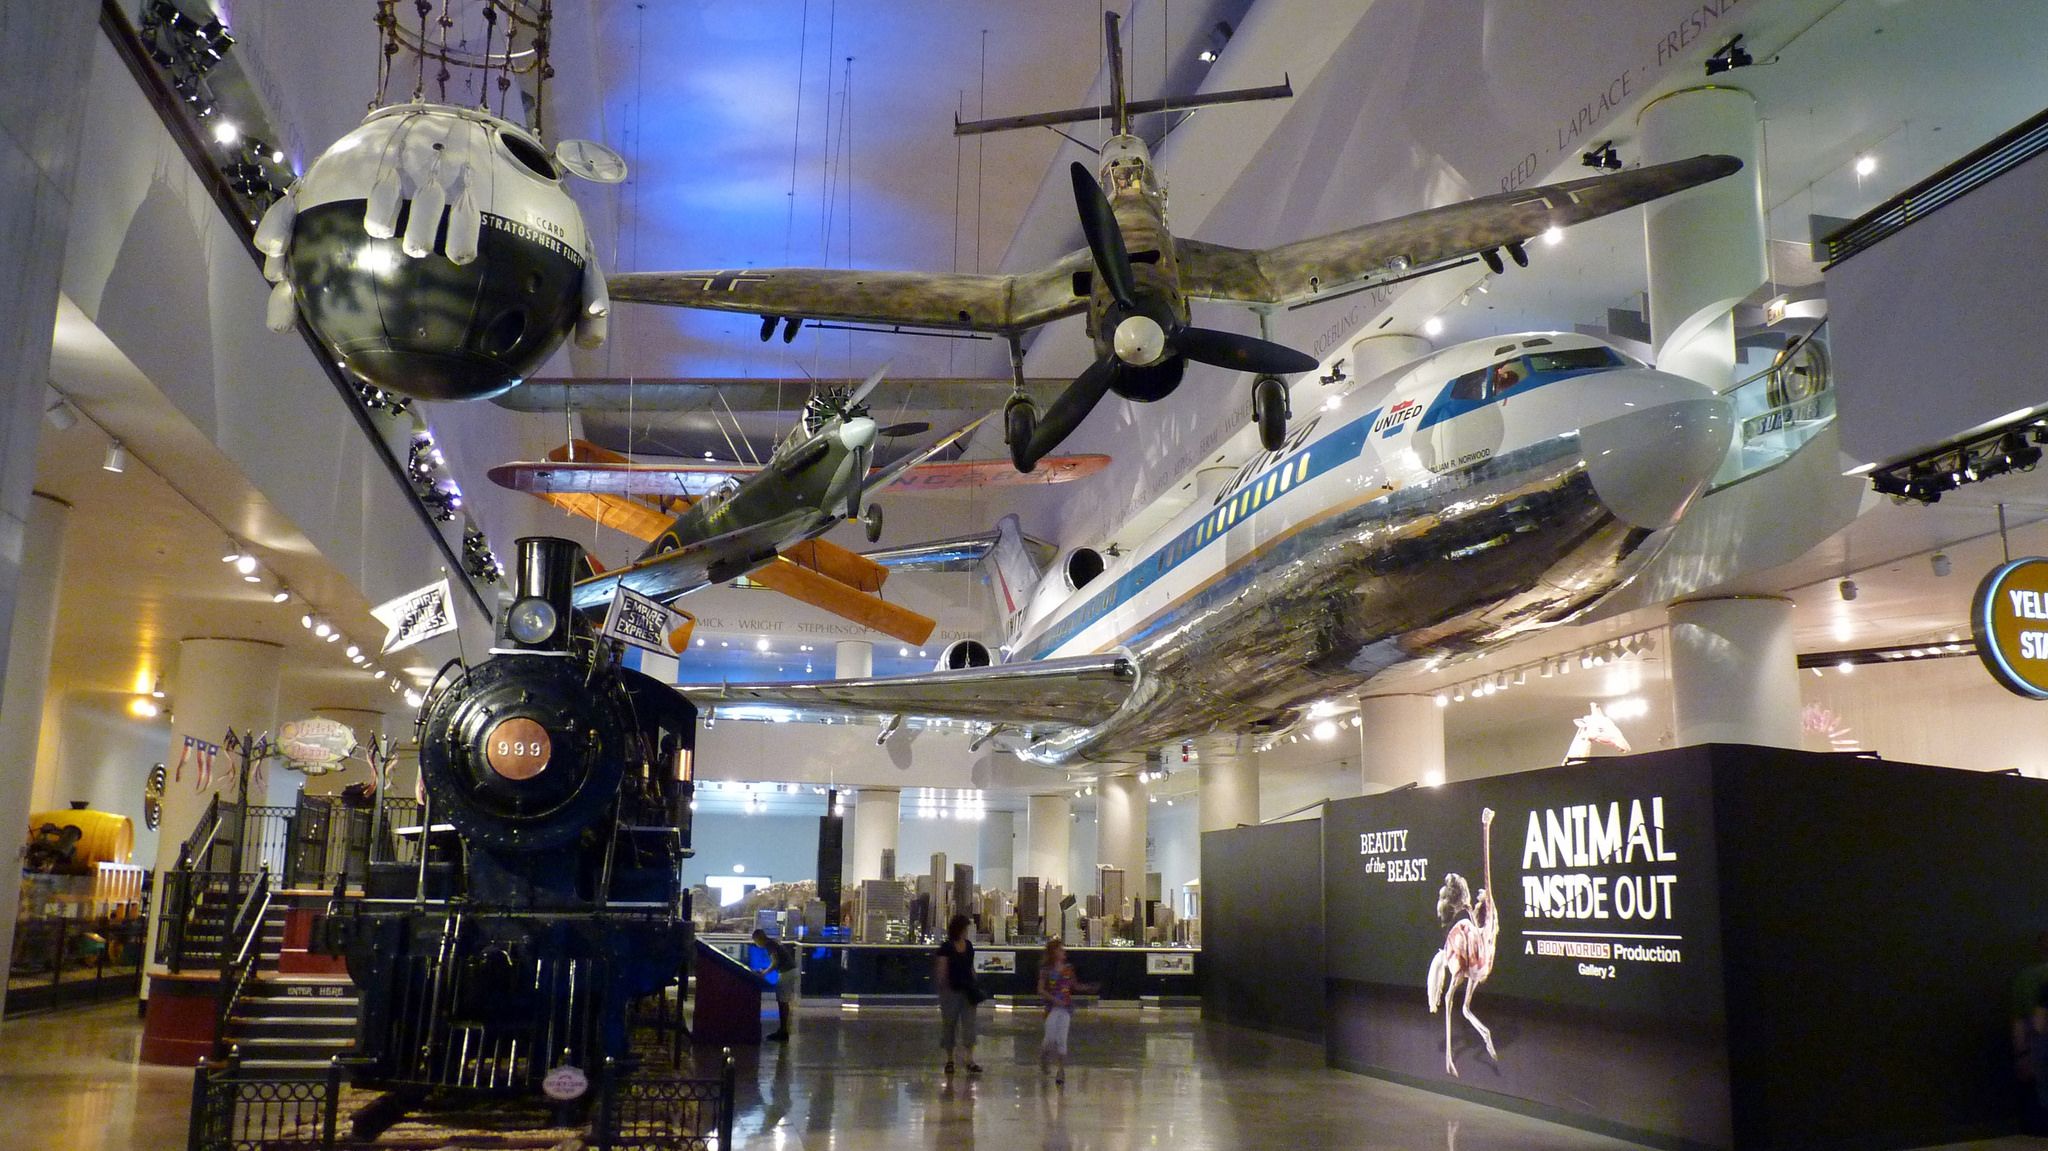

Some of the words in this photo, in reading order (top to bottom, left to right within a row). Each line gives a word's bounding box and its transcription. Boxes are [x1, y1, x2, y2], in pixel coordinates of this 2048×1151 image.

[1558, 71, 1630, 150] LAPLACE
[481, 214, 561, 254] STRATOSPHERE
[1313, 305, 1358, 358] ROEBLING
[1375, 405, 1423, 433] UNITED
[1458, 448, 1491, 464] NORWOOD
[405, 605, 436, 627] STATE
[622, 598, 666, 628] EMPIRE
[628, 612, 655, 631] STATE
[616, 618, 661, 644] EXPRESS
[738, 619, 784, 631] WRIGHT
[797, 623, 867, 635] STEPHENSON
[498, 741, 541, 757] 999
[1360, 830, 1408, 855] BEAUTY
[1522, 797, 1677, 869] ANIMAL
[1365, 857, 1374, 873] of
[1374, 857, 1385, 872] the
[1387, 859, 1428, 882] BEAST
[1522, 874, 1609, 919] INSIDE
[1615, 875, 1677, 920] OUT
[1525, 940, 1534, 955] A
[1613, 943, 1681, 963] Production
[1578, 963, 1608, 979] Gallery
[1608, 966, 1616, 978] 2
[288, 987, 312, 996] ENTER
[320, 987, 344, 997] HERE
